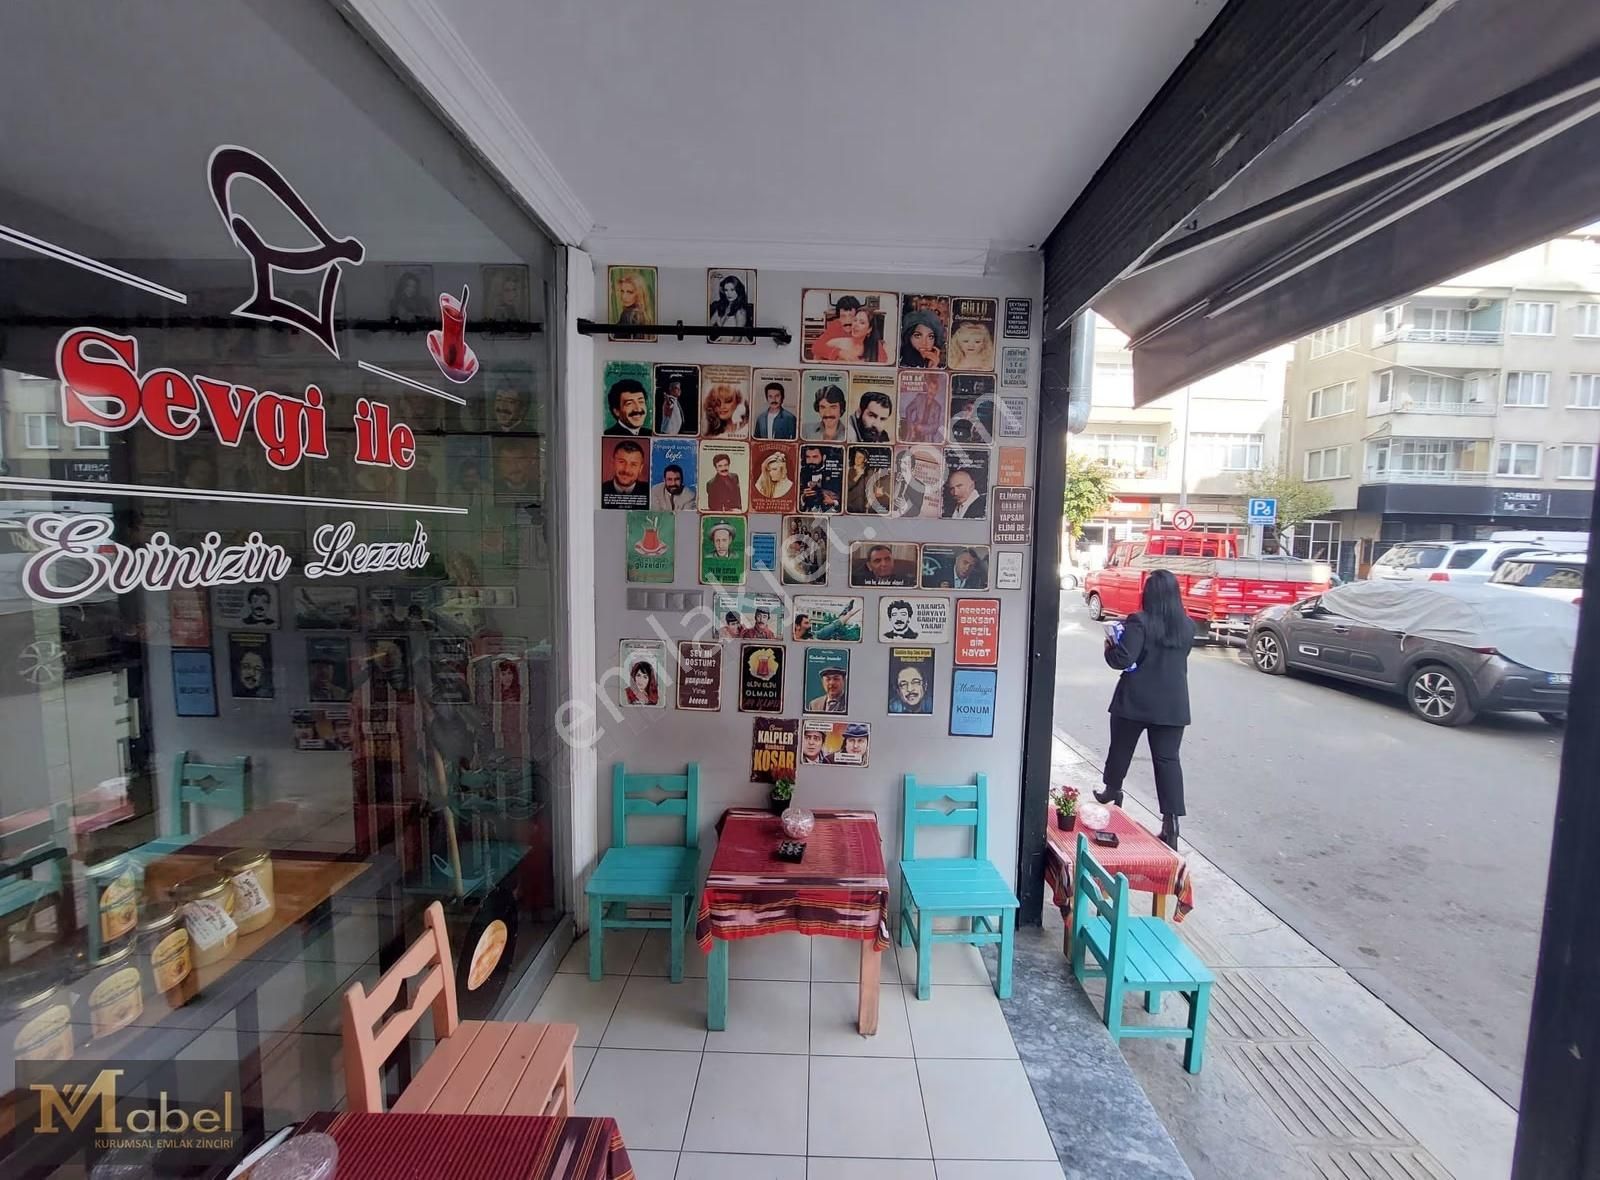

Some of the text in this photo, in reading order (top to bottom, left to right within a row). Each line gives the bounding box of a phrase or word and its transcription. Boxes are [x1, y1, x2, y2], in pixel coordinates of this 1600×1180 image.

[56, 327, 416, 470] Sevgi ile
[1254, 501, 1267, 515] P
[999, 513, 1025, 522] YAPSAM
[1016, 524, 1026, 532] DE
[22, 513, 292, 604] Evinizin
[963, 624, 992, 636] REZİL
[961, 648, 992, 657] HAYAT
[685, 658, 717, 667] DOSTUM?
[745, 690, 777, 698] OLMADI
[956, 705, 990, 714] KONUM
[758, 730, 794, 746] KALPLER
